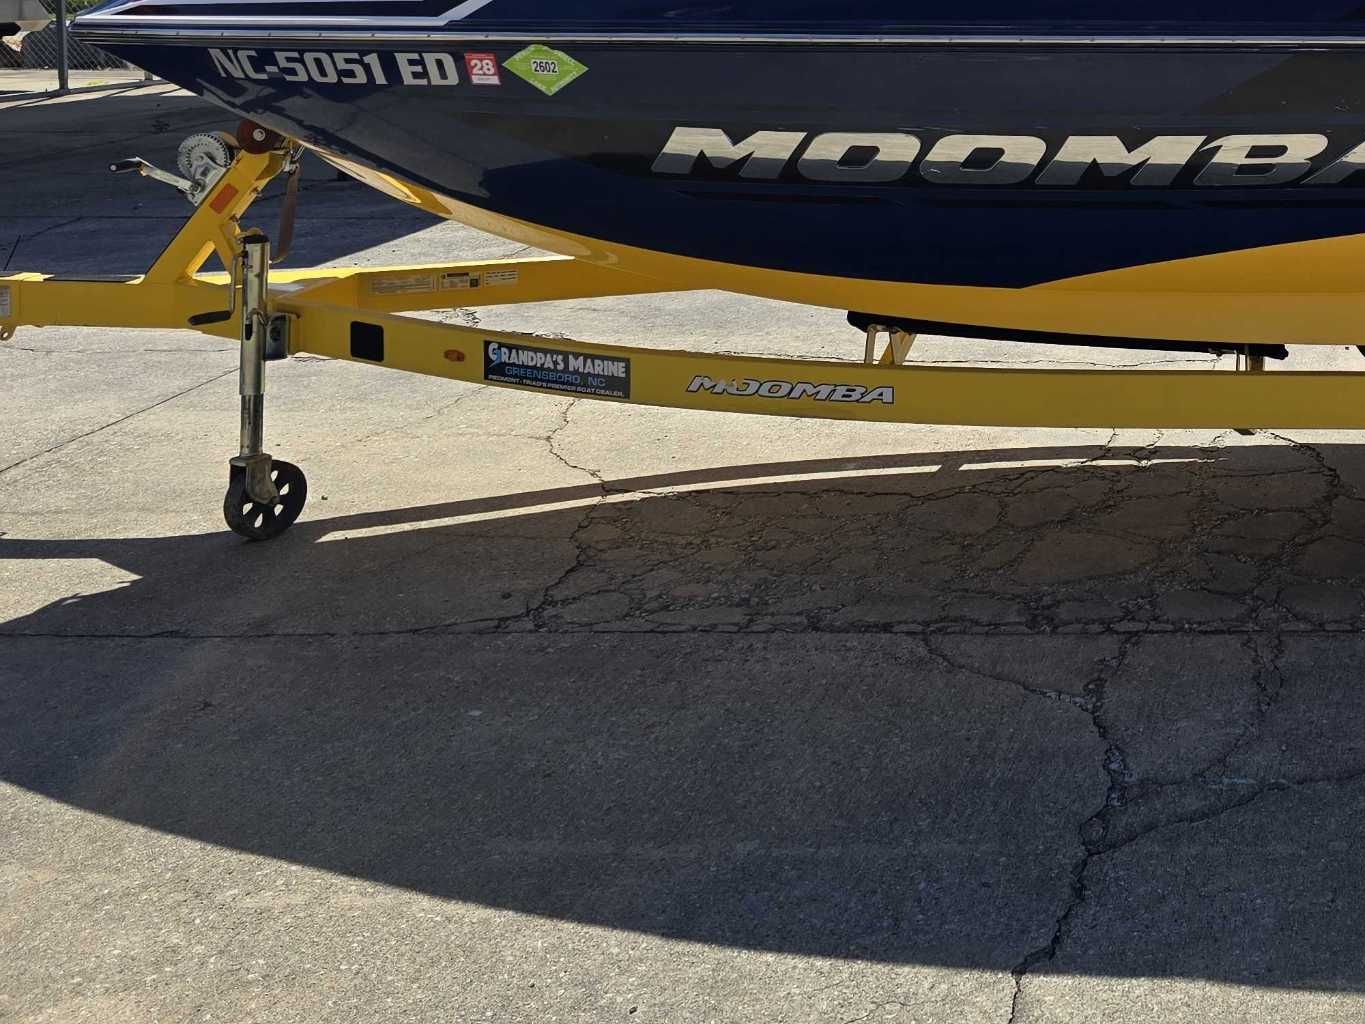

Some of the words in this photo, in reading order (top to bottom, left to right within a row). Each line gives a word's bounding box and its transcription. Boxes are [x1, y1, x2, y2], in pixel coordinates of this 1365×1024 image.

[398, 52, 459, 86] ED
[471, 59, 495, 75] 28
[532, 61, 558, 73] 2602
[488, 342, 564, 370] GRANDPA'S
[568, 354, 626, 377] MARINE
[588, 376, 606, 387] NC
[687, 375, 895, 404] MOOMBA
